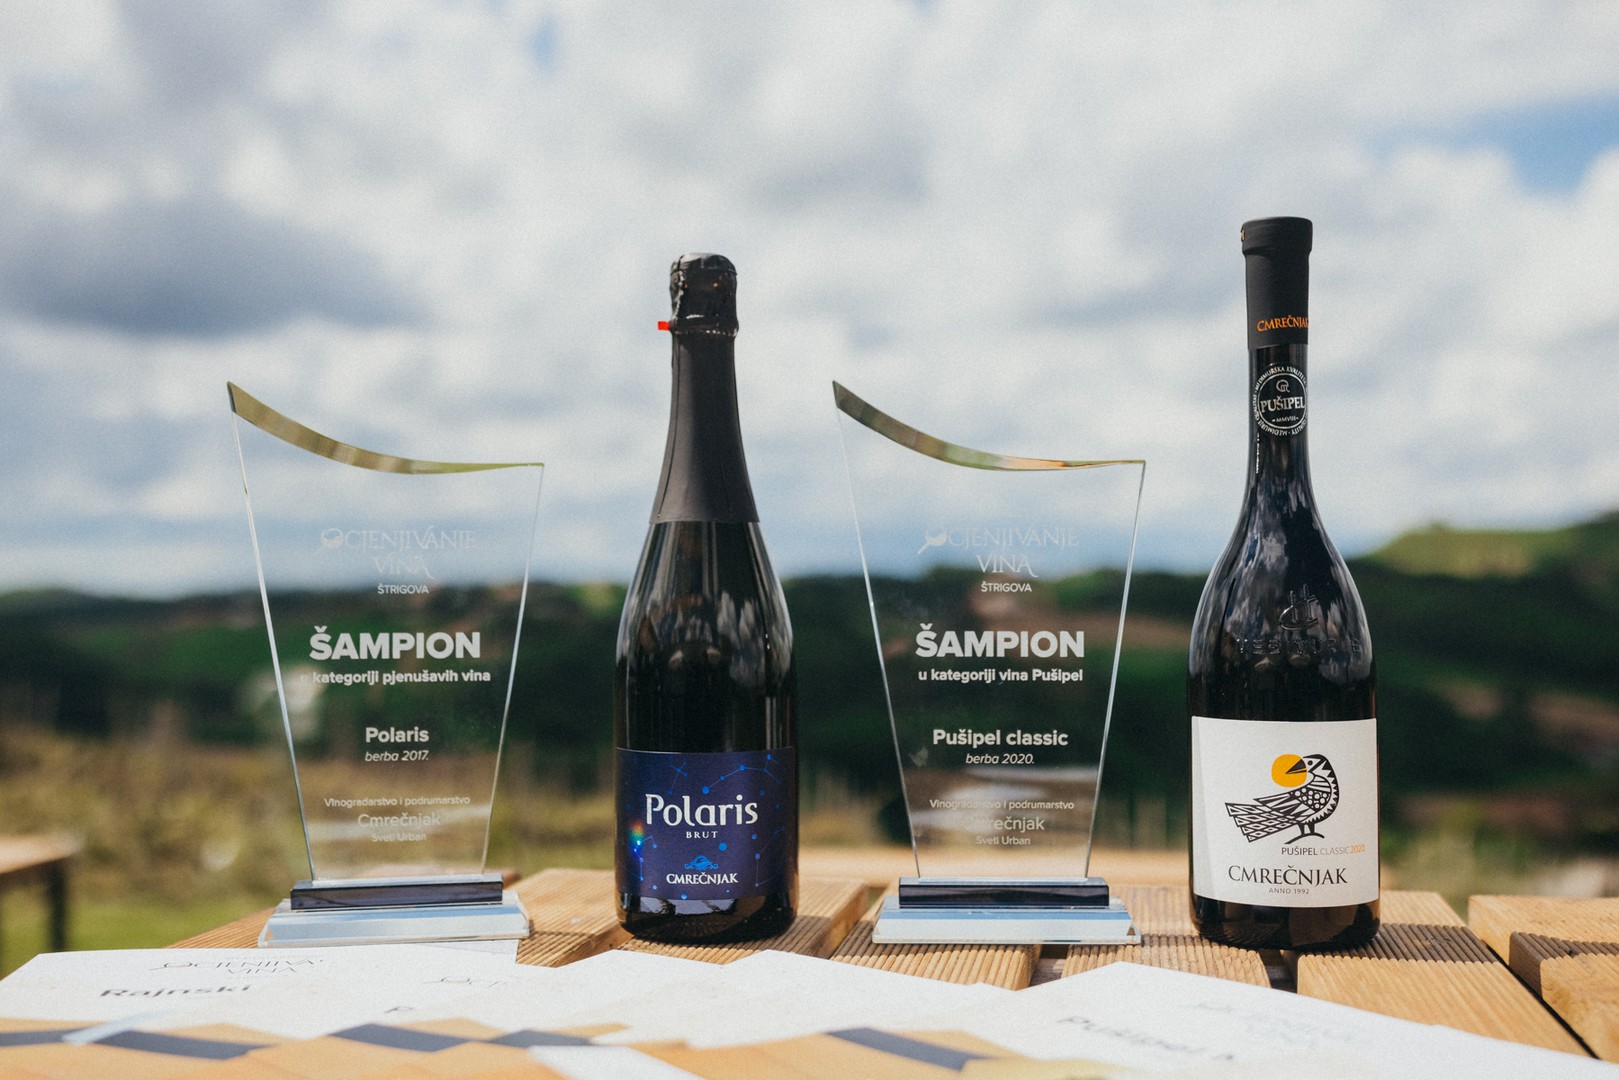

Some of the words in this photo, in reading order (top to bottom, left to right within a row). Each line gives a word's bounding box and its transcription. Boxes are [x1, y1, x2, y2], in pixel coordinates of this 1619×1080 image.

[1260, 395, 1306, 413] PUŠIPEL
[372, 553, 434, 579] VINA
[975, 551, 1038, 578] VINA
[377, 583, 430, 595] ŠTRIGOVA
[981, 580, 1032, 593] ŠTRIGOVA
[308, 625, 481, 660] ŠAMPION
[915, 623, 1085, 658] ŠAMPION
[313, 670, 380, 685] kategoriji
[382, 669, 459, 686] pjenušavih
[461, 669, 491, 682] vina
[918, 670, 927, 681] u
[931, 668, 996, 684] kategoriji
[999, 669, 1028, 681] vina
[1032, 667, 1083, 684] Pušipel
[365, 726, 430, 743] Polaris
[933, 728, 1001, 748] Pušipel
[1005, 729, 1069, 746] classic
[365, 751, 399, 762] berba
[402, 750, 430, 761] 2017.
[966, 753, 1000, 764] berba
[1001, 754, 1035, 764] 2020.
[324, 798, 398, 809] Vinogradarstvo
[404, 796, 471, 808] podrumarstvo
[645, 793, 759, 827] Polaris
[1008, 800, 1075, 811] podrumarstvo
[358, 812, 441, 832] Cmrečnjak
[371, 832, 395, 842] Sveti
[397, 832, 427, 842] Urban
[686, 831, 718, 839] BRUT
[975, 836, 1000, 846] Sveti
[1001, 835, 1031, 846] Urban
[1281, 845, 1318, 856] PUŠIPEL
[1320, 846, 1350, 857] CLASSIC
[1350, 844, 1366, 855] 2020
[666, 871, 739, 886] CMREČNJAK
[1228, 864, 1348, 888] CMREČNJAK
[1268, 887, 1292, 895] ANNO
[1293, 887, 1311, 896] 1992
